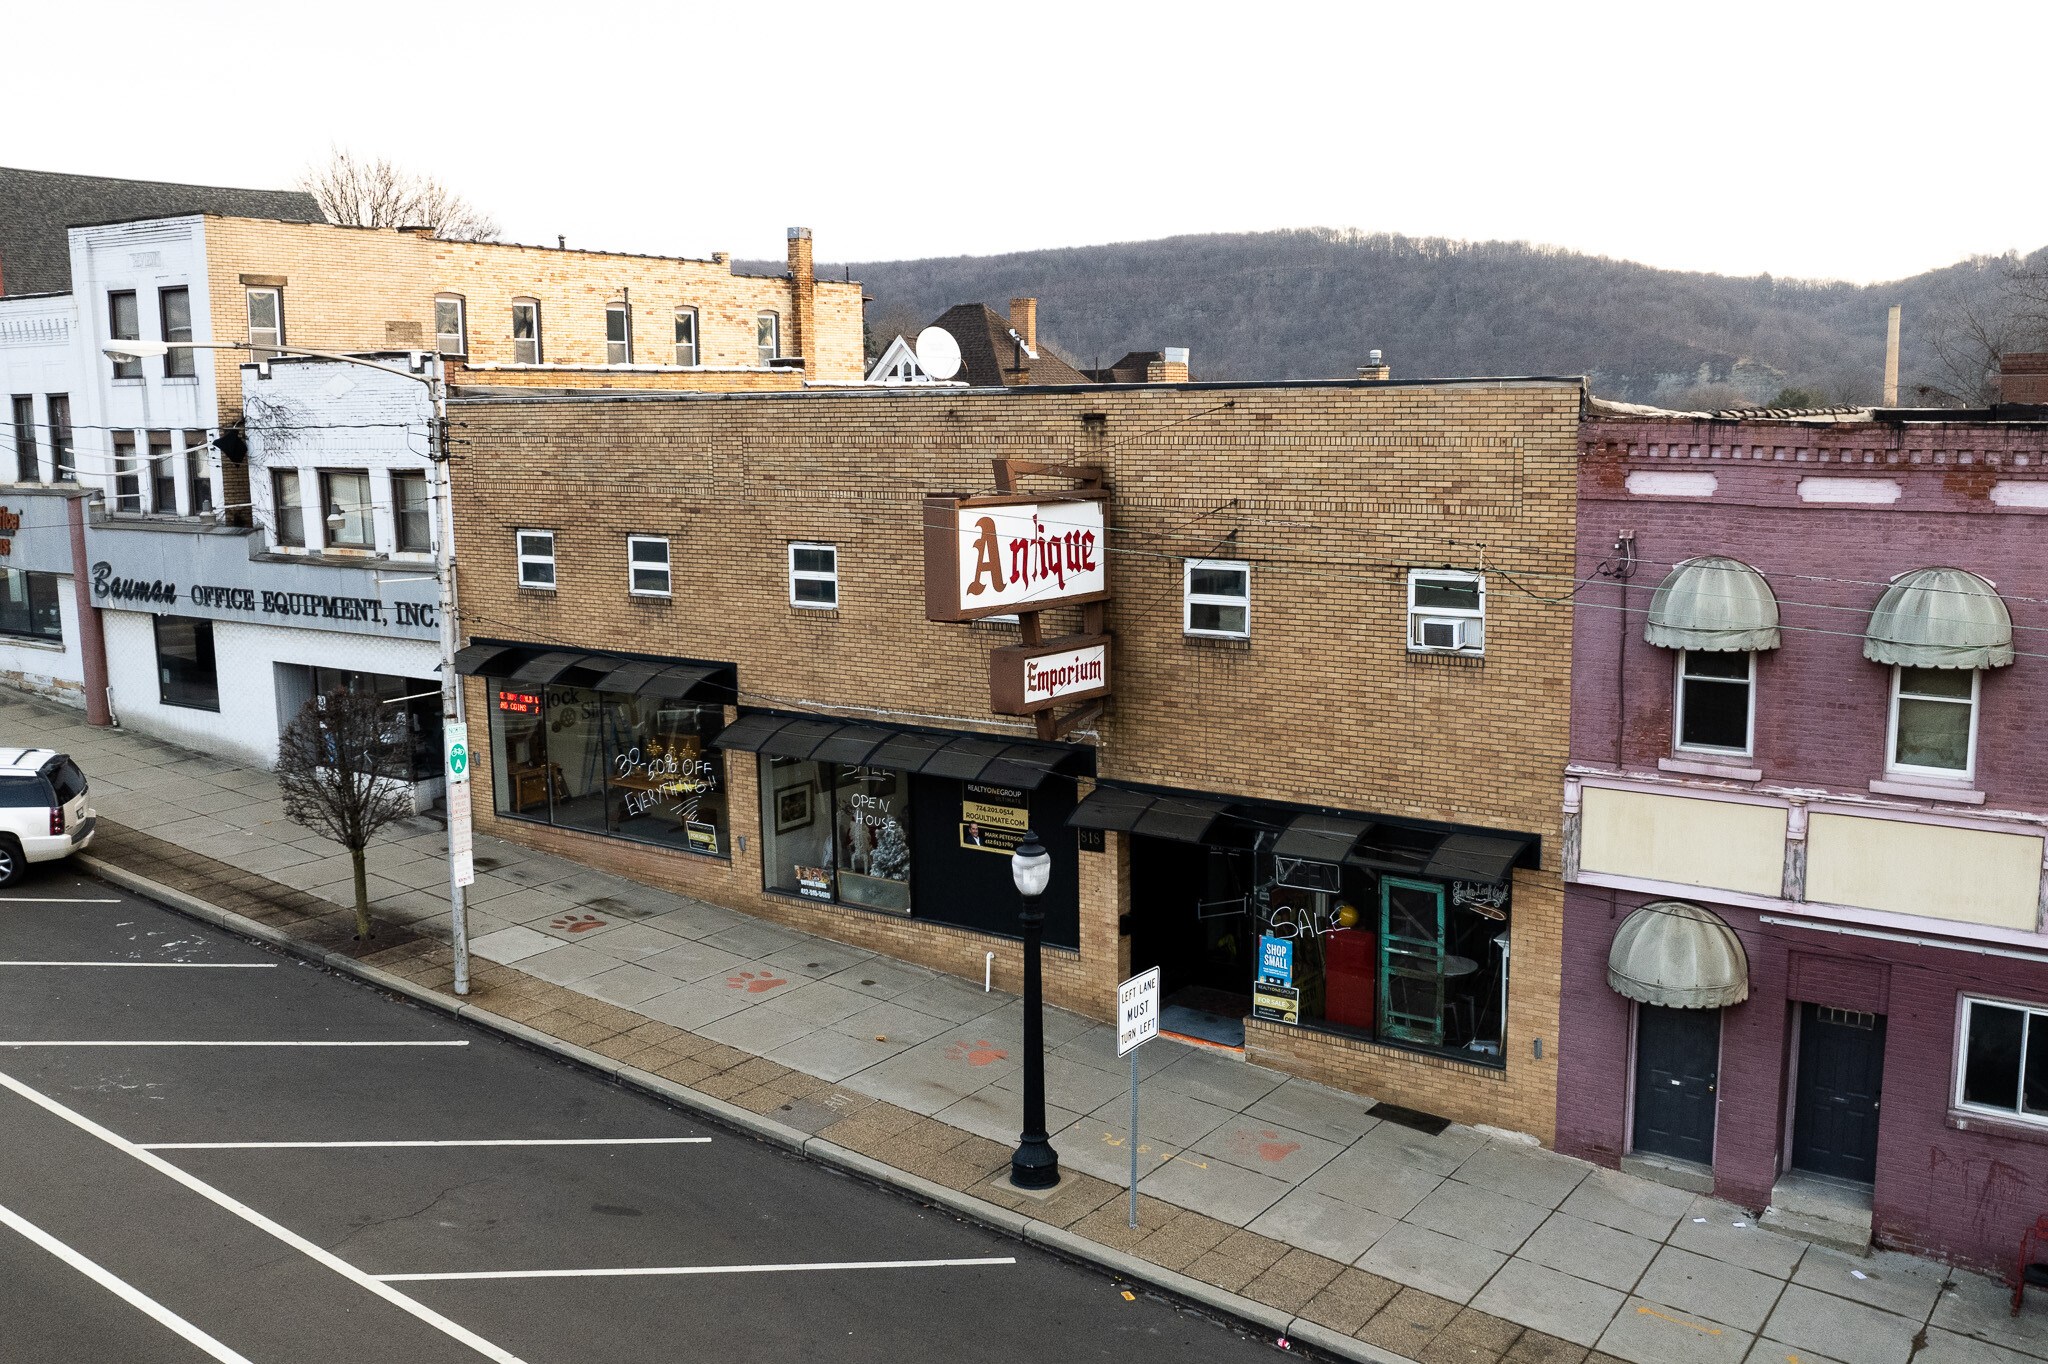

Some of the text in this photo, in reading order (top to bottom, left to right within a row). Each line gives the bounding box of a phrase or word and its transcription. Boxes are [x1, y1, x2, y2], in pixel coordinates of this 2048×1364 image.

[966, 513, 1096, 596] Antique
[92, 561, 440, 628] Bauman OFFICE EQUIPMENT, INC.
[1026, 655, 1102, 696] Emporium
[545, 687, 580, 709] lock
[455, 758, 463, 770] A
[682, 758, 712, 776] OFF
[851, 793, 890, 812] OPEN
[856, 810, 896, 830] HOUSE
[966, 812, 1026, 827] ROGULTIMATE.COM
[1080, 830, 1100, 844] 818
[1270, 905, 1351, 938] SALE
[1266, 943, 1287, 958] SHOP
[1264, 954, 1288, 970] SMALL
[1122, 978, 1156, 1004] LEFT LANE
[1128, 1000, 1149, 1022] MUST
[1258, 996, 1286, 1008] FOR SALE
[1122, 1018, 1155, 1045] TURN LEFT
